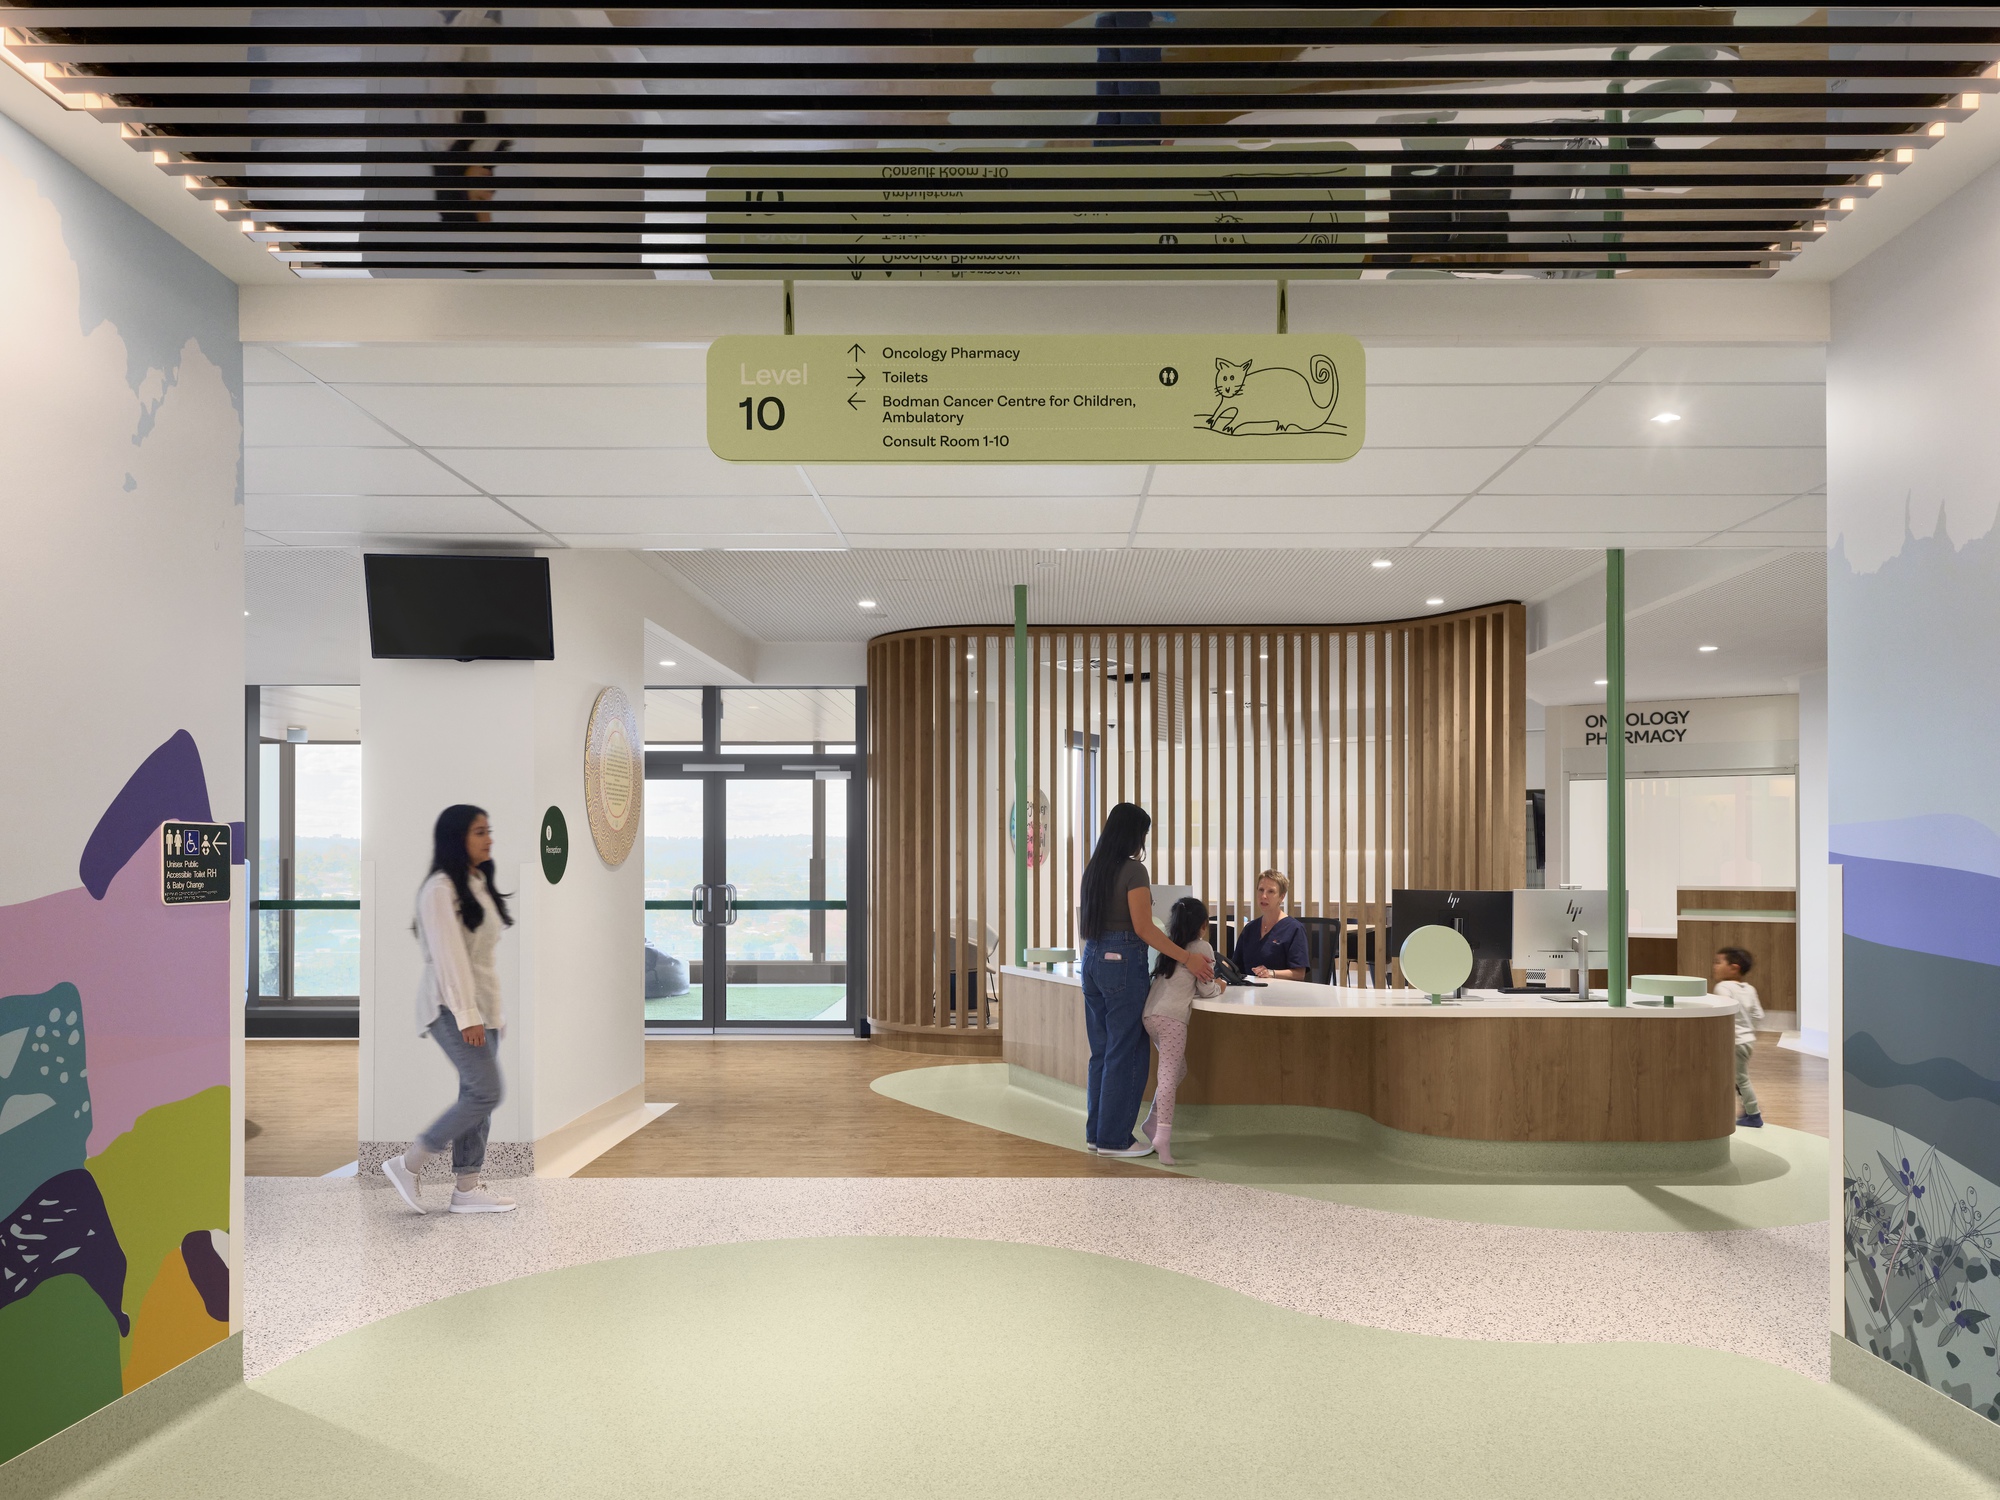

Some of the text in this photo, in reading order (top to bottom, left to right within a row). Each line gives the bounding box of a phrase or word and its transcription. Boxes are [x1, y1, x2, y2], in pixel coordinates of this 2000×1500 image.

[882, 347, 1021, 362] Oncology Pharmacy
[740, 362, 808, 386] Level
[882, 371, 929, 383] Toilets
[883, 395, 1136, 408] Bodman Cancer Centre for Children,
[739, 396, 786, 431] 10
[882, 411, 964, 426] Ambulatory
[882, 435, 1010, 447] Consult Room 1-10
[1585, 710, 1690, 728] ONOLOGY
[1586, 728, 1687, 745] PHRMACY
[166, 860, 199, 868] Unisex Public
[166, 868, 217, 879] Accessible Toilet RH
[166, 881, 205, 890] & Baby Change
